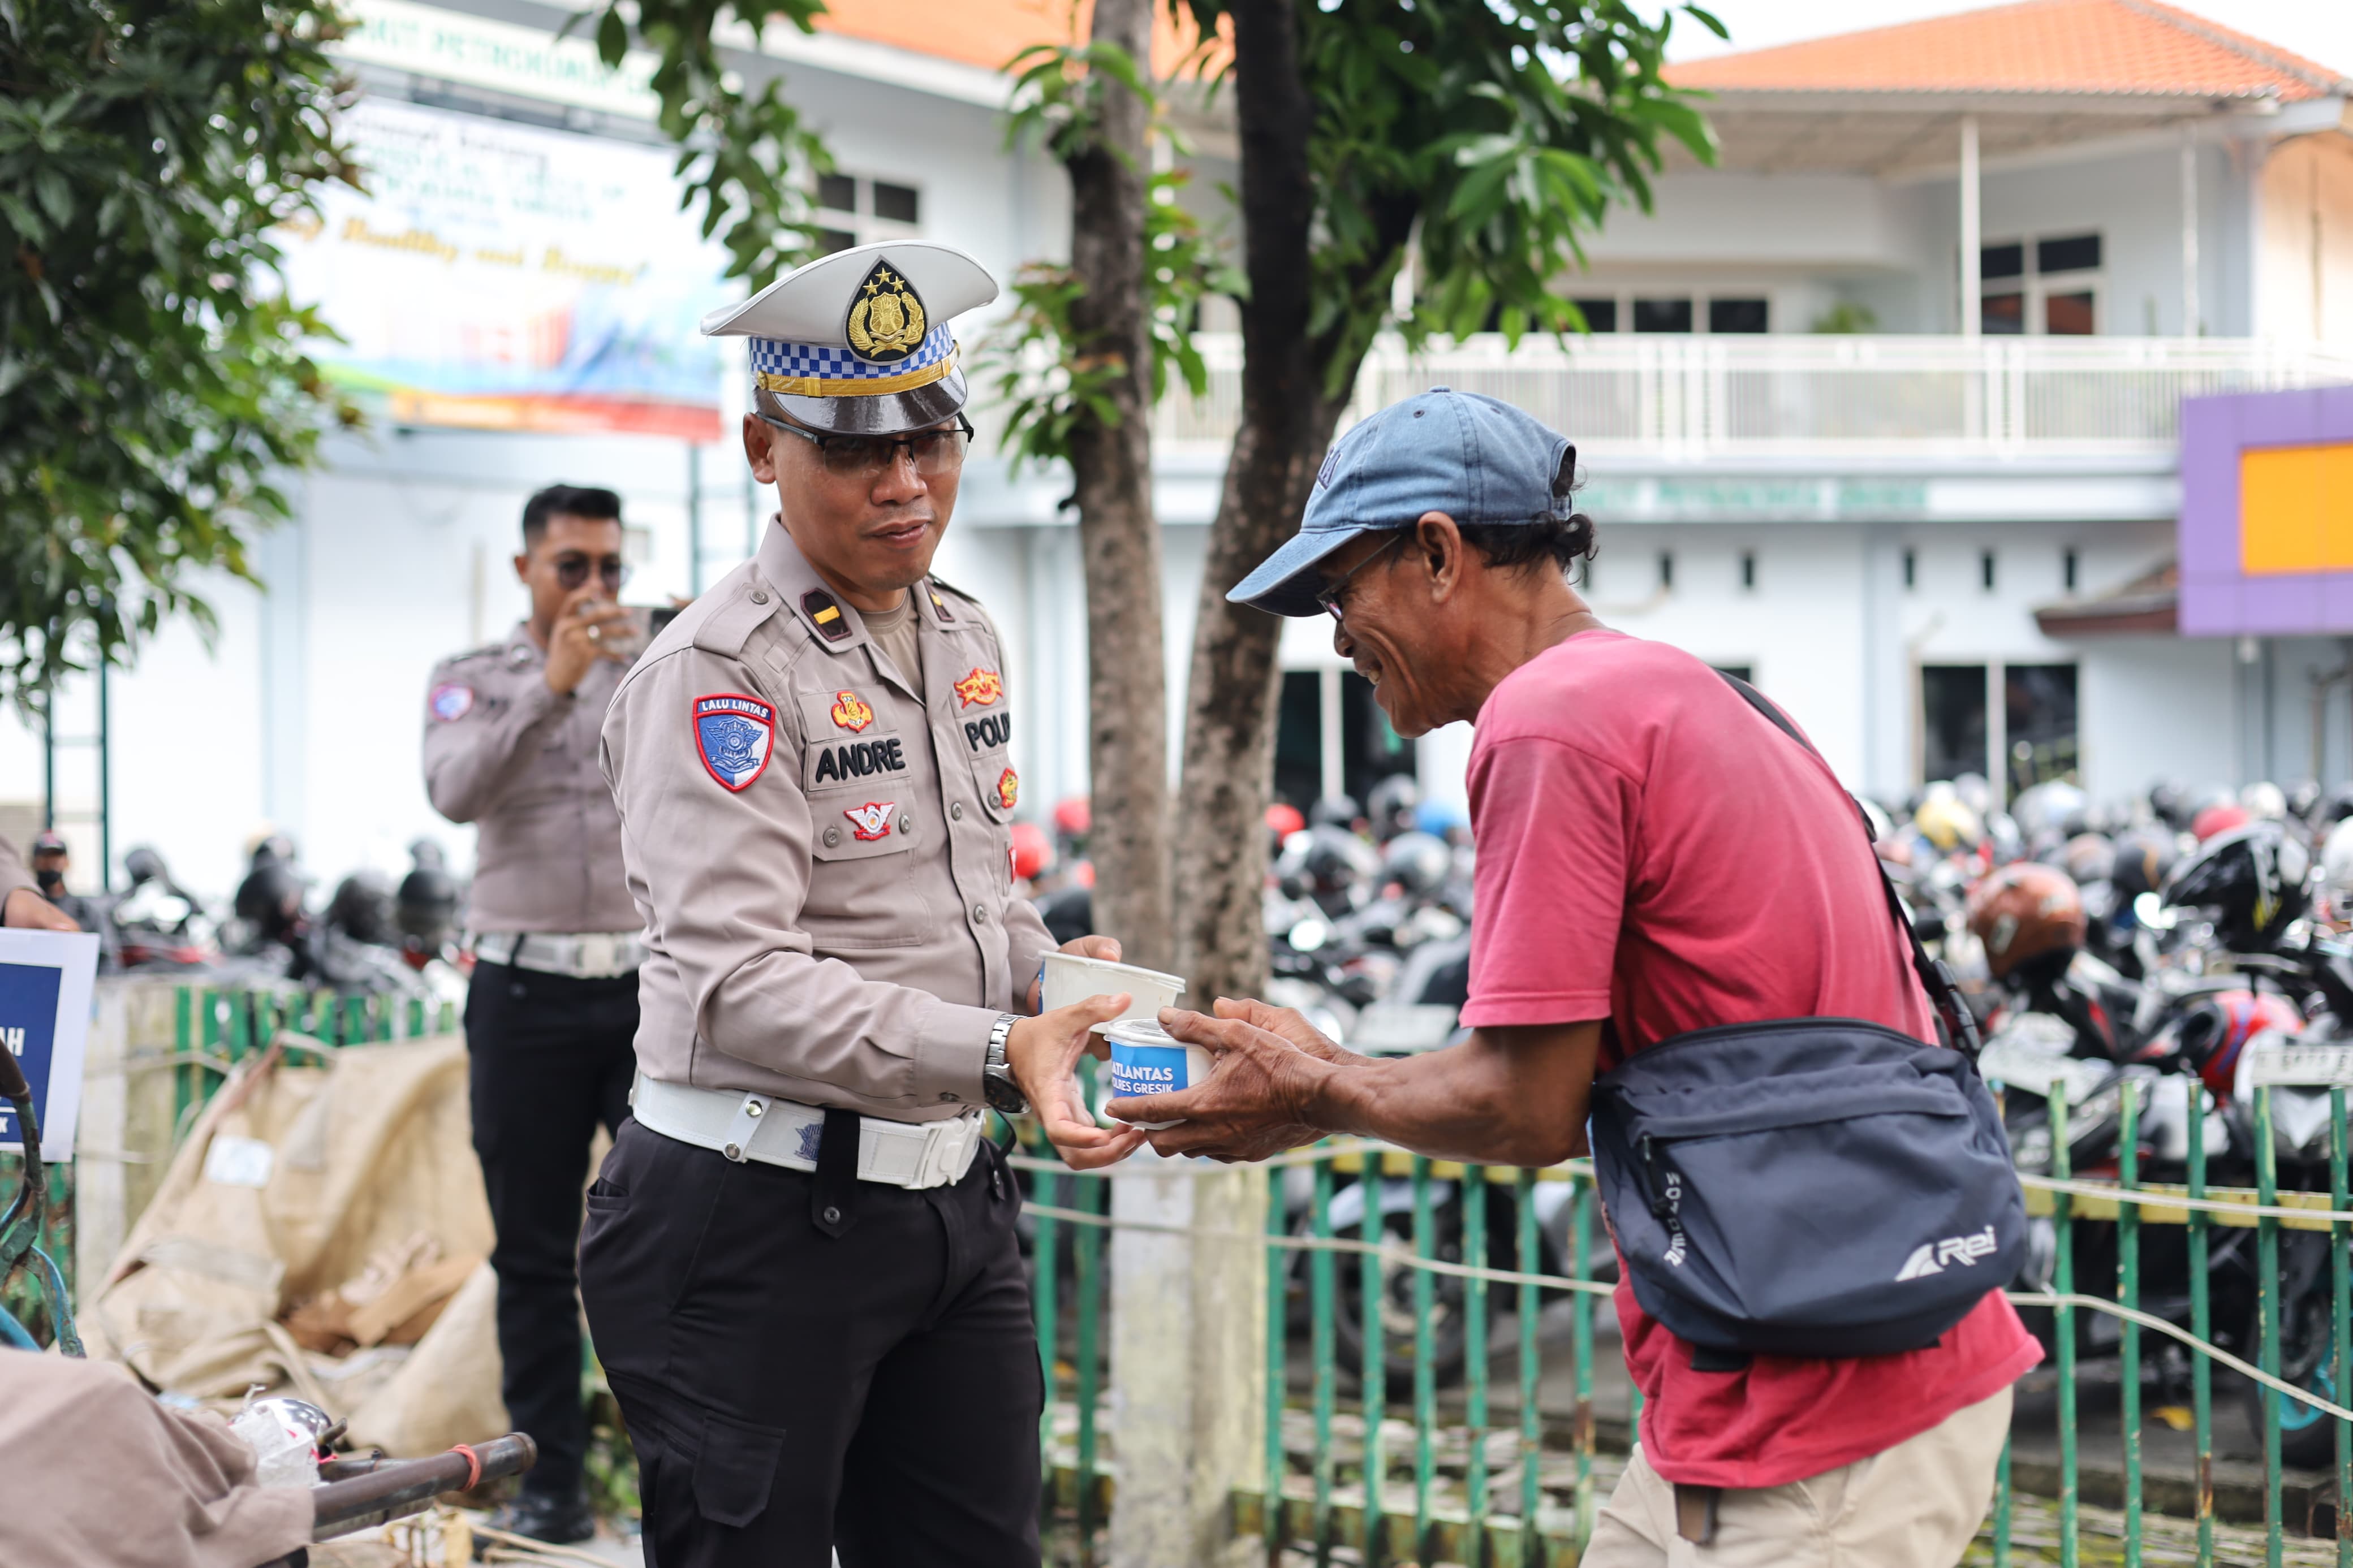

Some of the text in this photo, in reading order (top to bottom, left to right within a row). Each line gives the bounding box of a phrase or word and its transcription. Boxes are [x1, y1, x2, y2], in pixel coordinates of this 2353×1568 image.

[701, 699, 769, 718] LALU LINTAS
[815, 738, 906, 783] ANDRE
[1112, 1061, 1174, 1081] ATLANTAS
[1132, 1082, 1174, 1095] GRESIK
